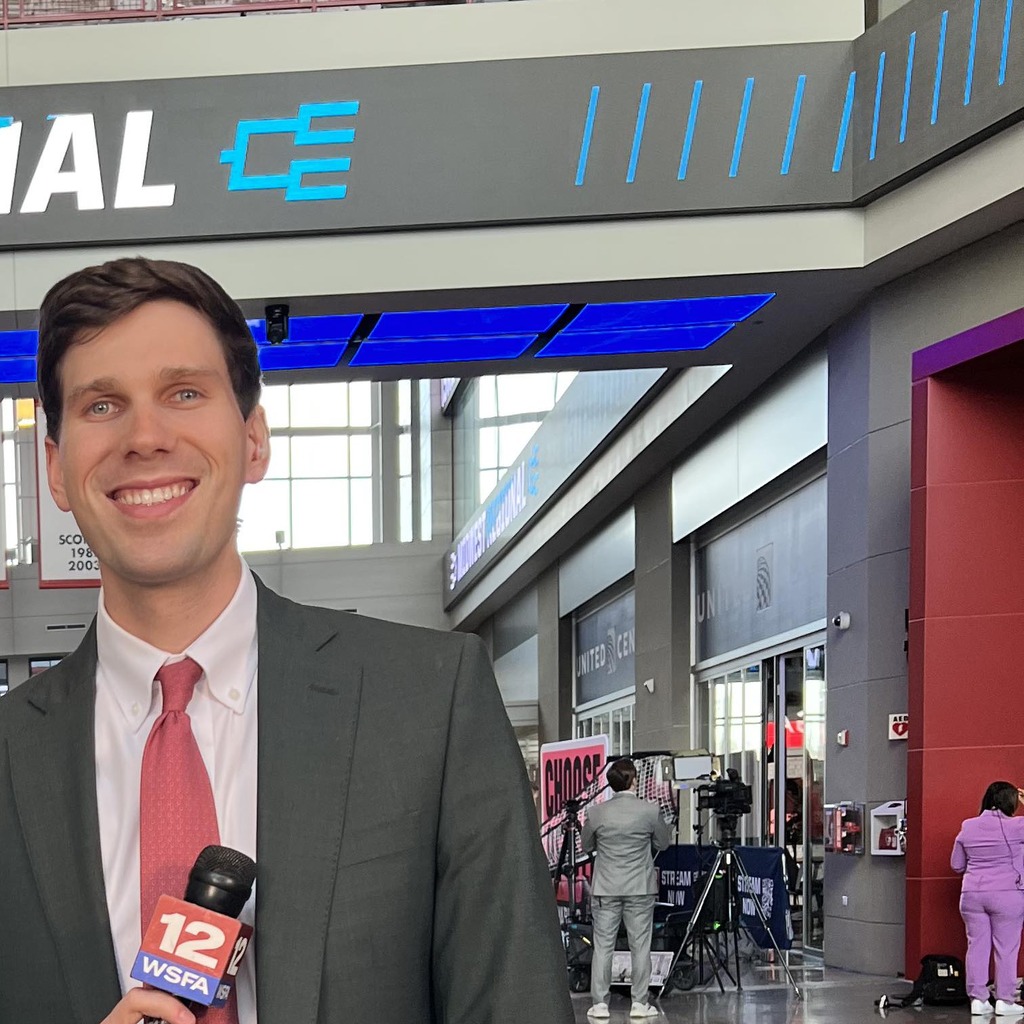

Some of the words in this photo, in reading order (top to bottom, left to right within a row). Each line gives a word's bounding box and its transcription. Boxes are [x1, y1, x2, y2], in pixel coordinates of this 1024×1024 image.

[577, 643, 606, 677] UNITED
[617, 628, 636, 659] CEN
[545, 754, 601, 818] CHOOSE
[159, 912, 226, 970] 12
[142, 955, 209, 995] WSFA
